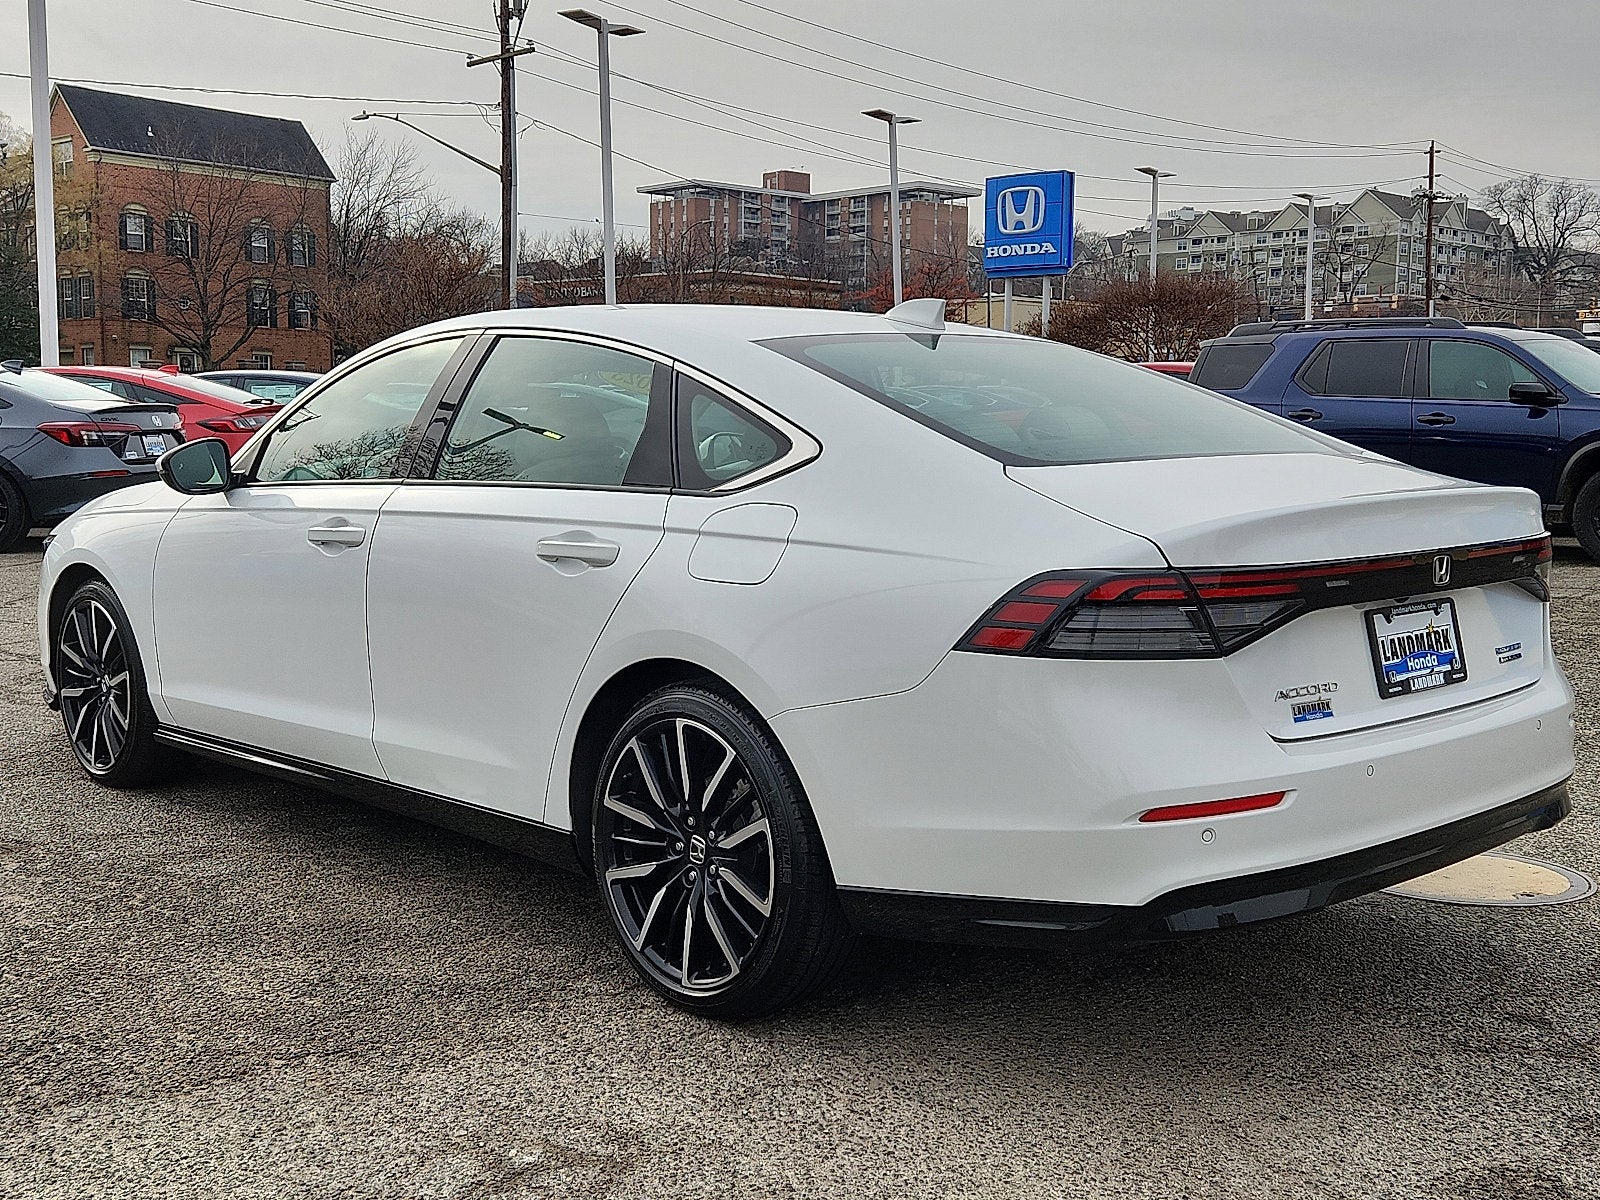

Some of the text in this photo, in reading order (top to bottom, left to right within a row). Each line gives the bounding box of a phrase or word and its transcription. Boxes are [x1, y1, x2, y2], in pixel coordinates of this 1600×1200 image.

[986, 242, 1057, 258] HONDA
[1380, 627, 1453, 663] LANDMARK
[1407, 653, 1439, 671] Honda
[1410, 673, 1445, 691] LANDMARK
[1273, 681, 1339, 703] ACCORD
[1292, 701, 1332, 717] LANDMARK
